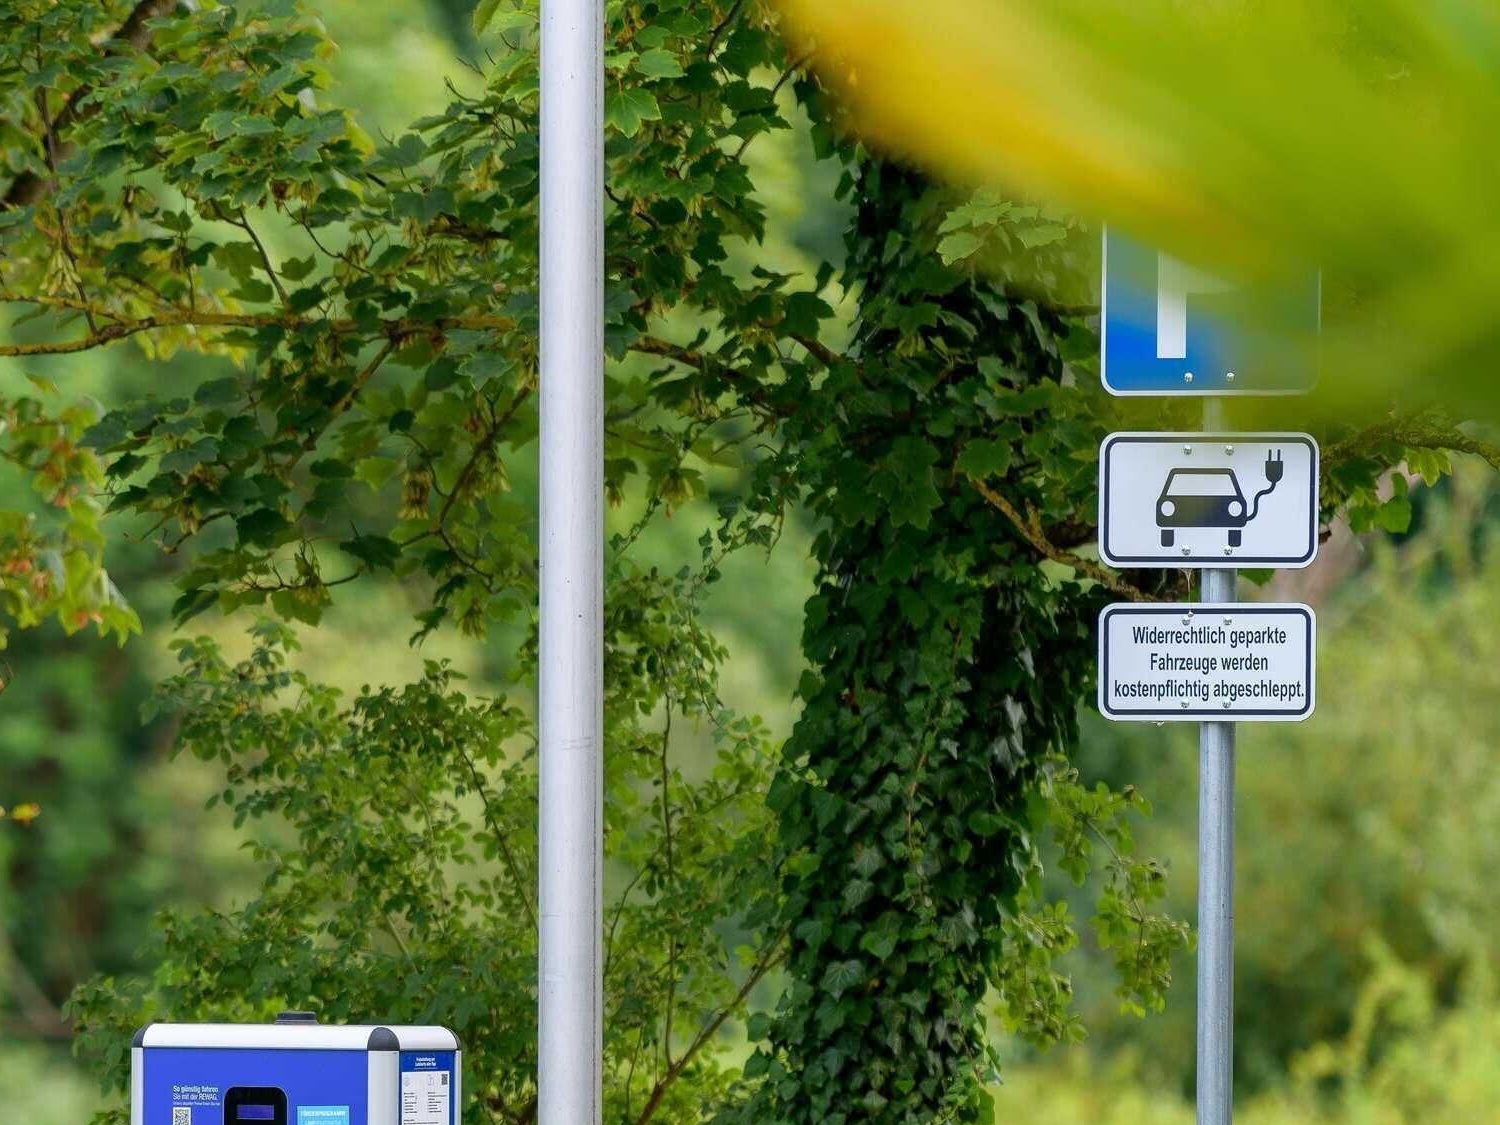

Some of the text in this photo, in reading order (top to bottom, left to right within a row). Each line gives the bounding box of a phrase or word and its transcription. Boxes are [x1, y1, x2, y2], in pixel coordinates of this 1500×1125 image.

[1132, 626, 1287, 648] Widerrechtlich geparkte
[1150, 653, 1268, 675] Fahrzeuge werden
[1114, 679, 1305, 701] kostenpflichtig abgeschleppt.
